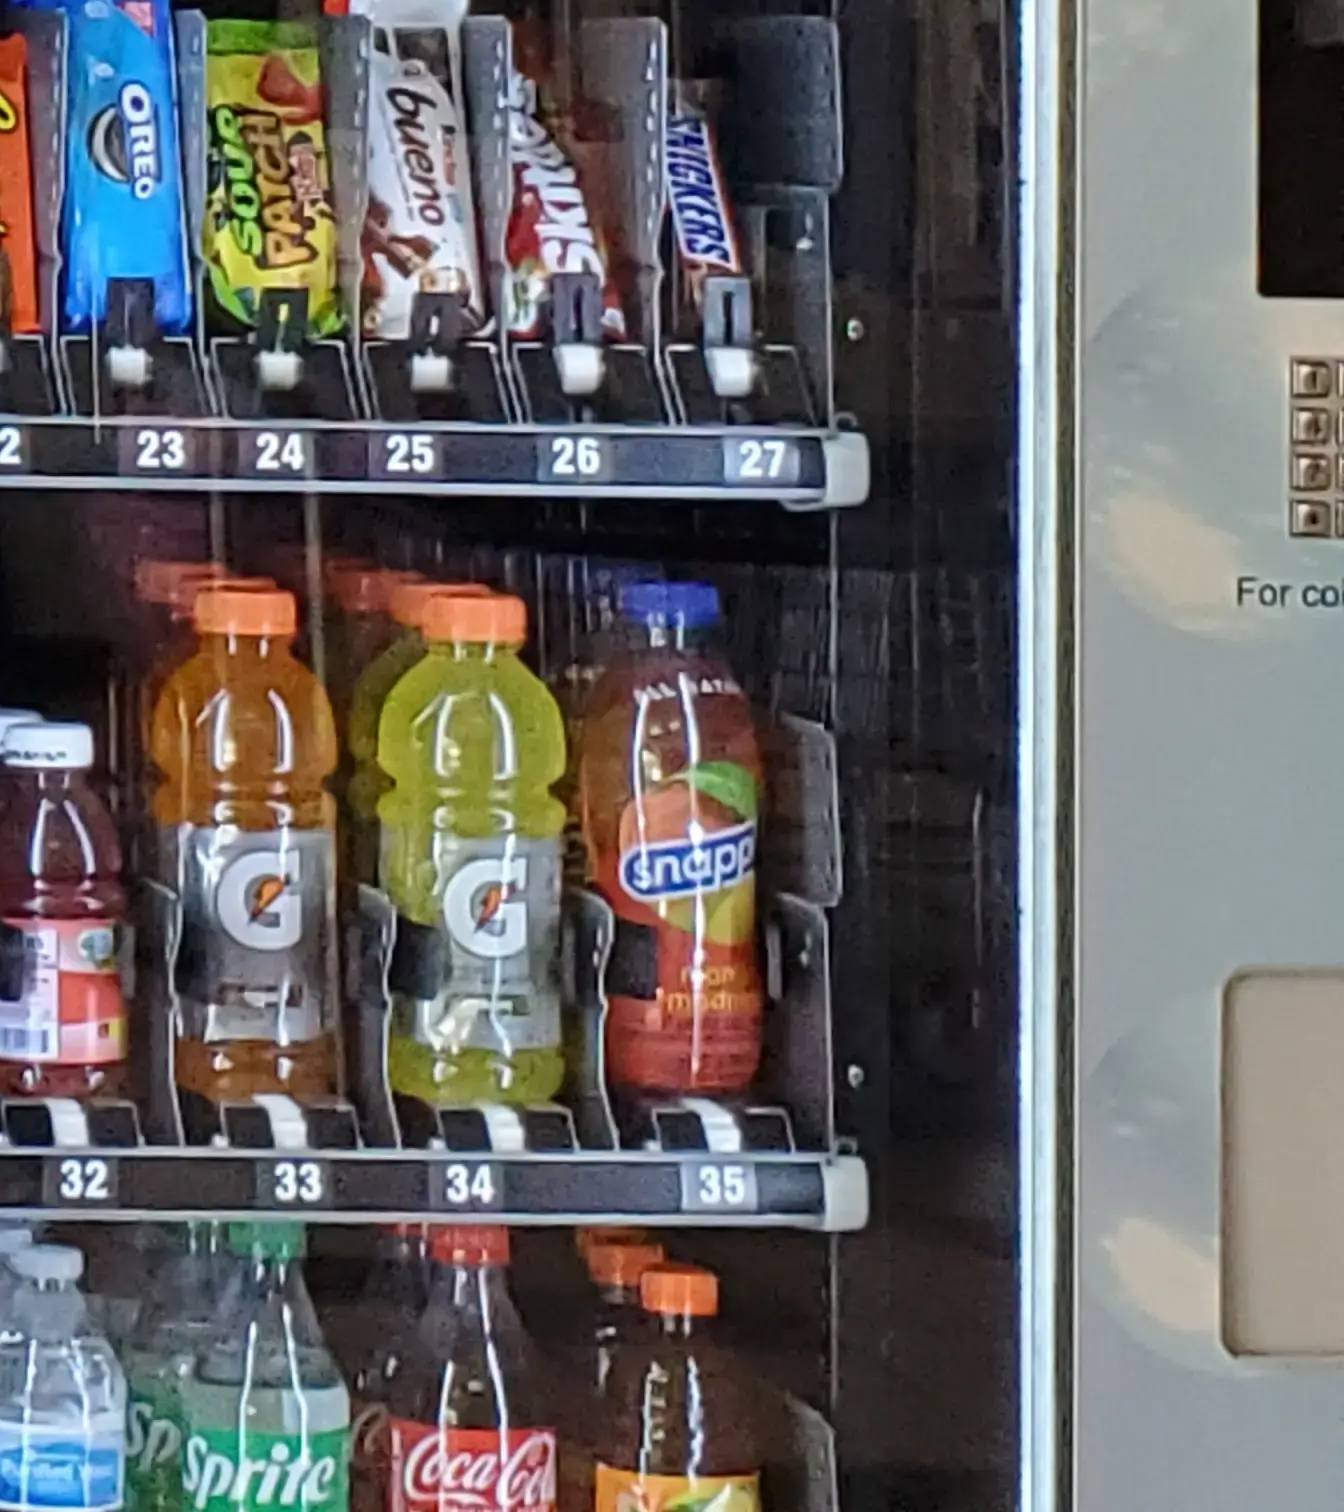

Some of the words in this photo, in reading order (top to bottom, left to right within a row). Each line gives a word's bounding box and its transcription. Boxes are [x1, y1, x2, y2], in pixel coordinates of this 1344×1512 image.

[121, 82, 156, 201] OREO
[387, 88, 446, 227] bueno
[214, 104, 262, 257] SOUR
[667, 116, 732, 264] SNICKERS
[136, 430, 186, 469] 23
[255, 432, 305, 471] 24
[386, 434, 435, 474] 25
[551, 437, 600, 476] 26
[739, 440, 786, 478] 27
[1236, 576, 1292, 608] For
[217, 849, 302, 951] G
[444, 856, 529, 958] G
[59, 1161, 108, 1199] 32
[273, 1163, 323, 1202] 33
[445, 1164, 493, 1202] 34
[697, 1165, 745, 1204] 35
[182, 1435, 335, 1511] Sprite
